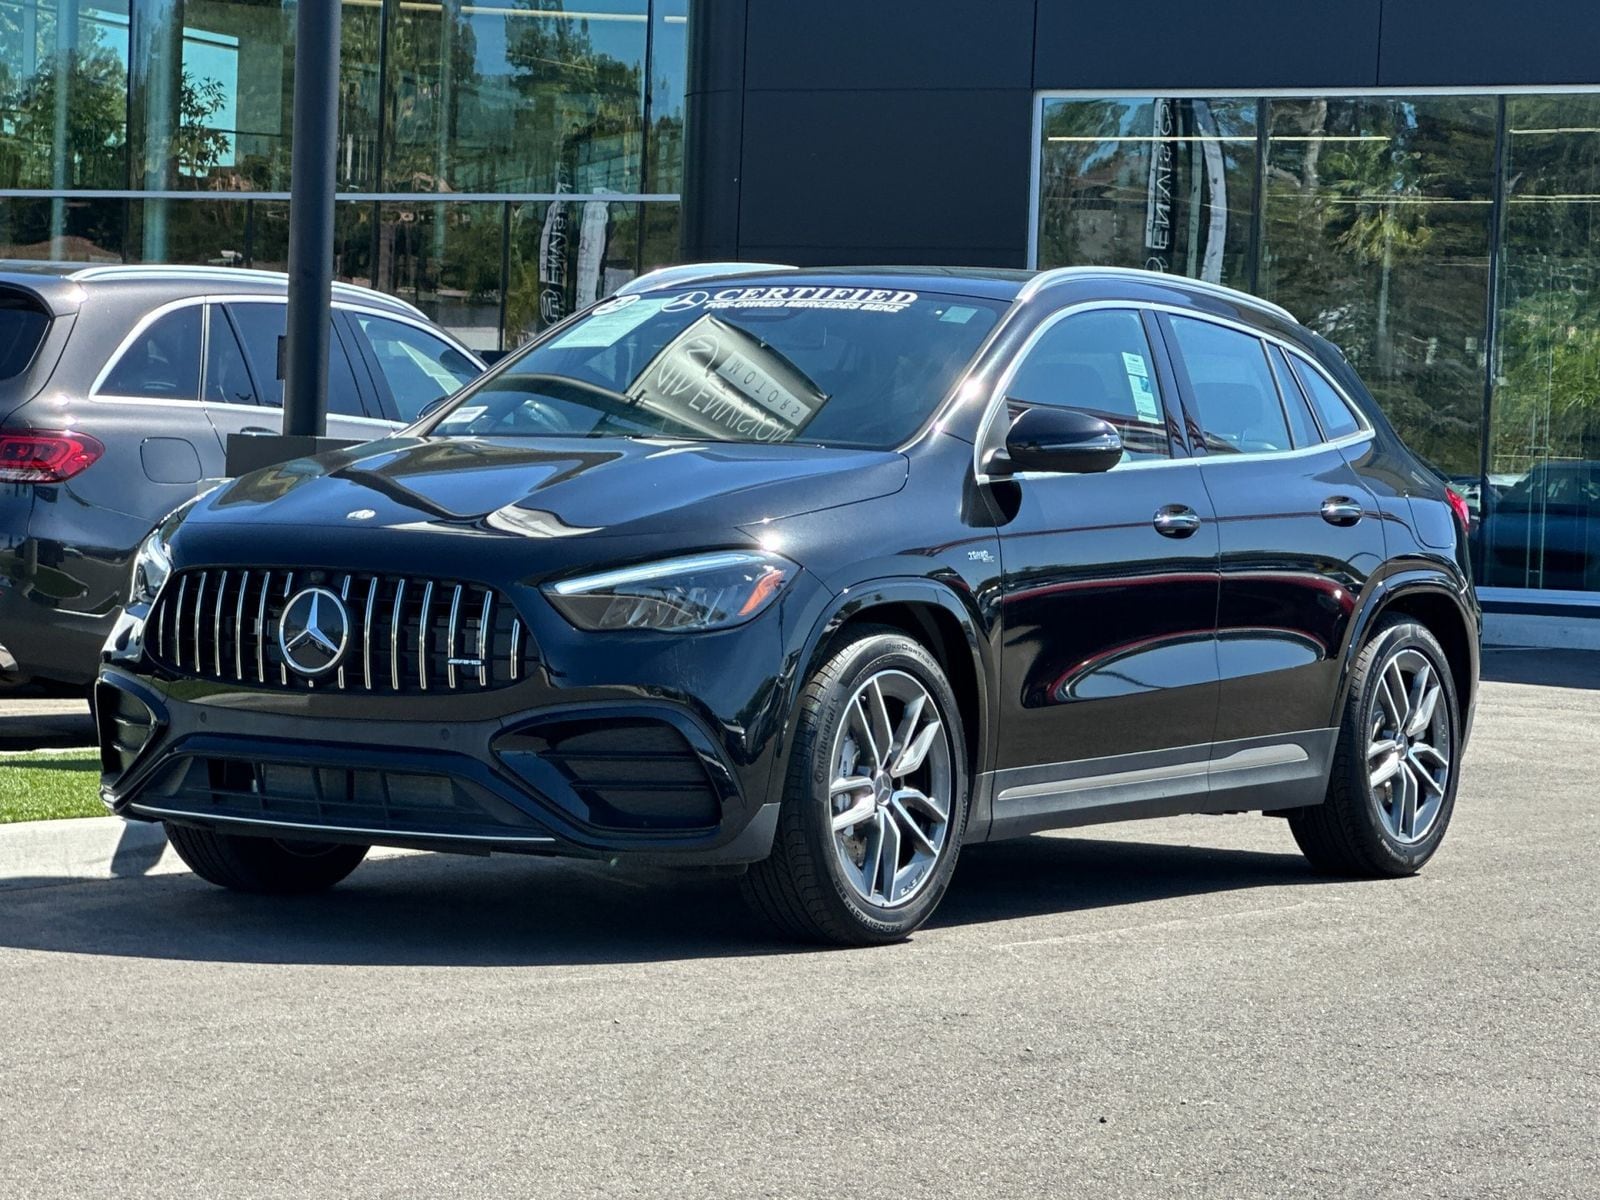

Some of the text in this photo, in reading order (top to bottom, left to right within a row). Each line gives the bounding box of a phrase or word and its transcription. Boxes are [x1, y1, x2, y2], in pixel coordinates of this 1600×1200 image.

[713, 287, 918, 303] CERTIFIED
[784, 301, 861, 310] MERCEDES
[860, 303, 904, 312] BENZ
